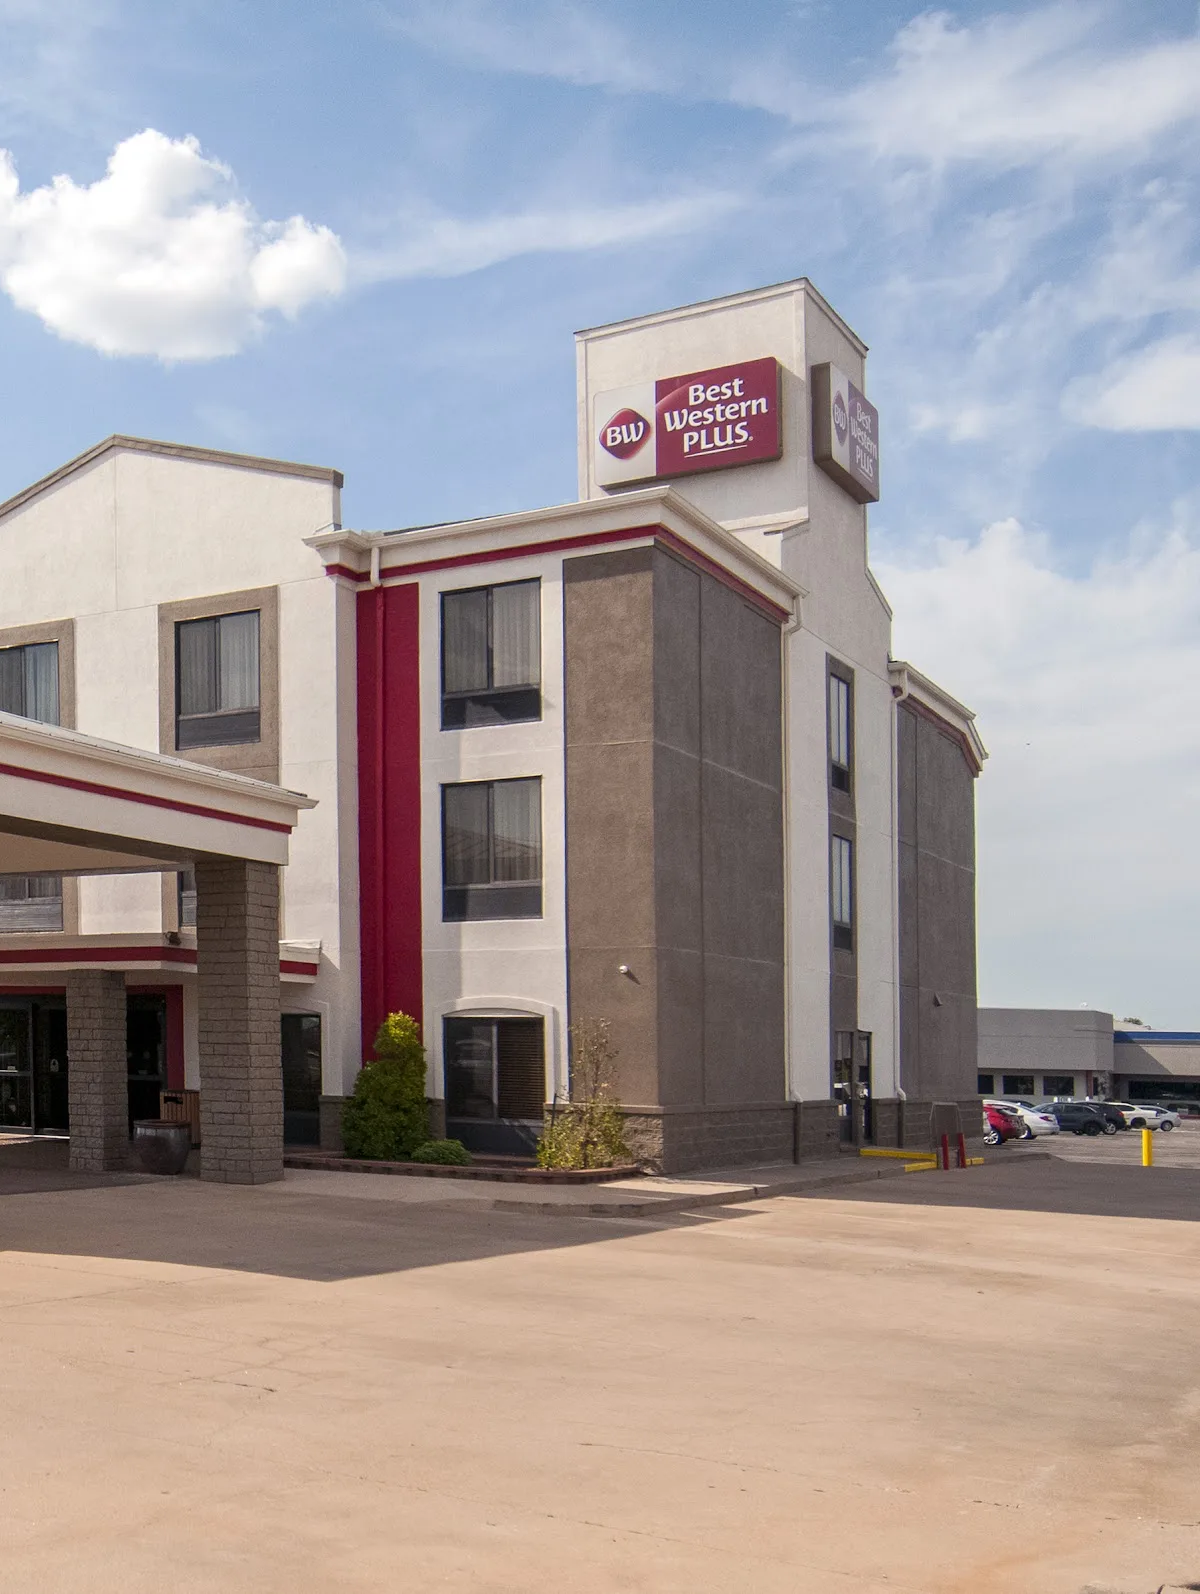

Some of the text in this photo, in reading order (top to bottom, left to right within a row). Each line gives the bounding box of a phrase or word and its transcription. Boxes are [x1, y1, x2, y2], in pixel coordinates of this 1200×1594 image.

[688, 377, 745, 406] Best
[663, 396, 768, 432] Western
[834, 404, 846, 430] BW
[856, 403, 872, 433] Best
[606, 422, 644, 447] BW
[683, 421, 749, 453] PLUS
[850, 416, 877, 460] Western
[855, 445, 874, 477] PLUS
